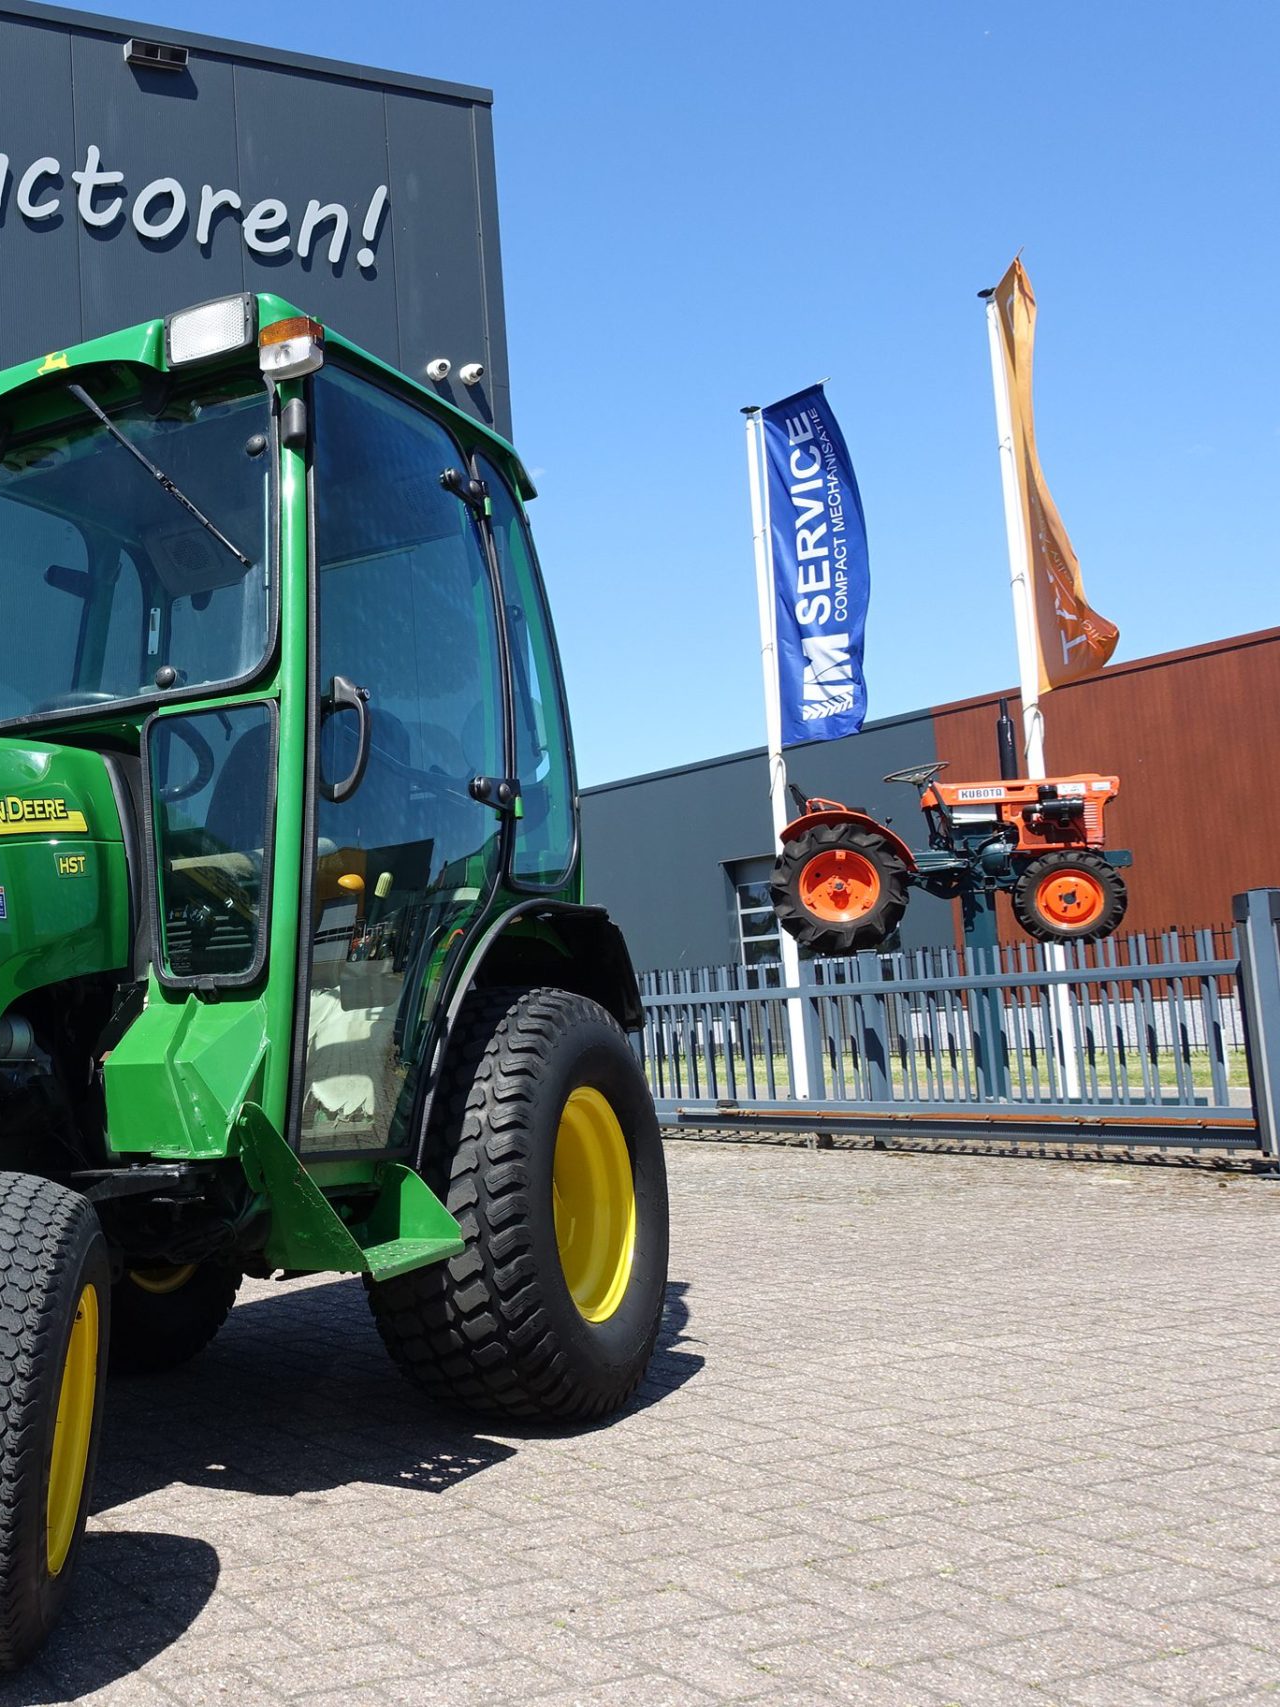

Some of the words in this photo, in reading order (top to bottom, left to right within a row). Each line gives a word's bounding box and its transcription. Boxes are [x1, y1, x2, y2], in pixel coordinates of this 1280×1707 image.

[807, 407, 846, 533] MECHANISATIE
[785, 411, 832, 626] SERVICE
[833, 536, 849, 622] COMPACT
[6, 794, 68, 821] DEERE
[960, 788, 1003, 799] KUBOTA
[59, 856, 86, 874] HST
